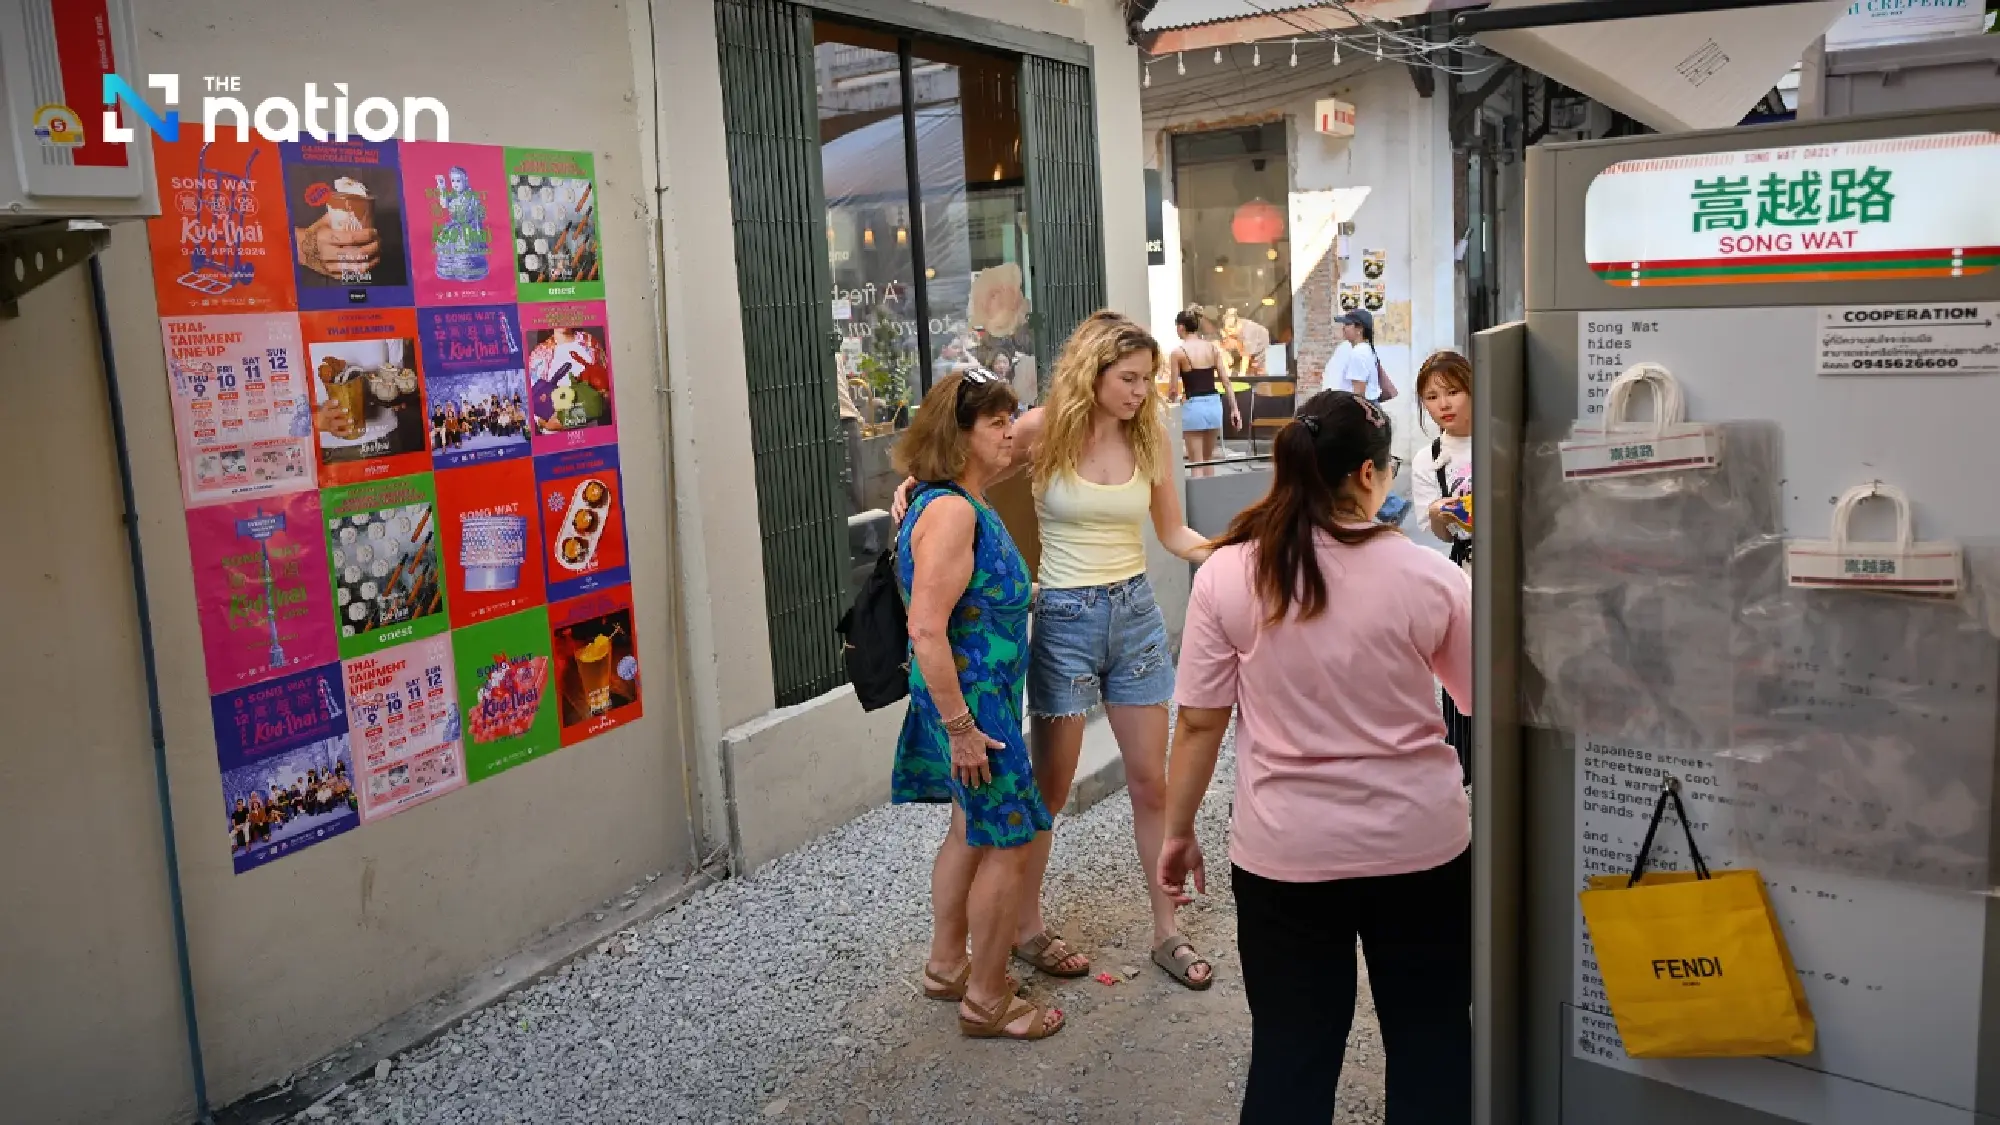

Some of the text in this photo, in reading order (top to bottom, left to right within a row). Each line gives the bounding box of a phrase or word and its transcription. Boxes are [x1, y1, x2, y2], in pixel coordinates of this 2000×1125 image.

[171, 177, 257, 192] SONG WAT
[1690, 165, 1896, 232] 嵩越路
[1719, 230, 1859, 254] SONG WAT
[211, 247, 234, 256] APR
[237, 247, 266, 256] 2026
[1844, 307, 1978, 322] COOPERATION
[1587, 321, 1659, 335] Song Wat
[170, 332, 244, 346] TAINMENT
[1587, 338, 1632, 350] hides
[172, 346, 226, 359] LINE-UP
[266, 348, 287, 357] SUN
[242, 357, 261, 366] SAT
[268, 356, 288, 369] 12
[1587, 354, 1623, 366] Thai
[216, 365, 233, 375] FRI
[245, 365, 261, 379] 11
[188, 375, 209, 384] THU
[216, 375, 236, 388] 10
[194, 385, 206, 398] 9
[379, 625, 413, 643] onest
[348, 660, 407, 683] TAINMENT
[427, 673, 442, 687] 12
[408, 686, 421, 699] 11
[387, 699, 402, 713] 10
[368, 713, 377, 726] 9
[1584, 742, 1652, 761] Japanese
[1584, 771, 1618, 786] Thai
[1685, 773, 1721, 787] cool
[1584, 800, 1634, 818] brands
[1583, 830, 1609, 844] and
[1652, 957, 1723, 979] FENDI
